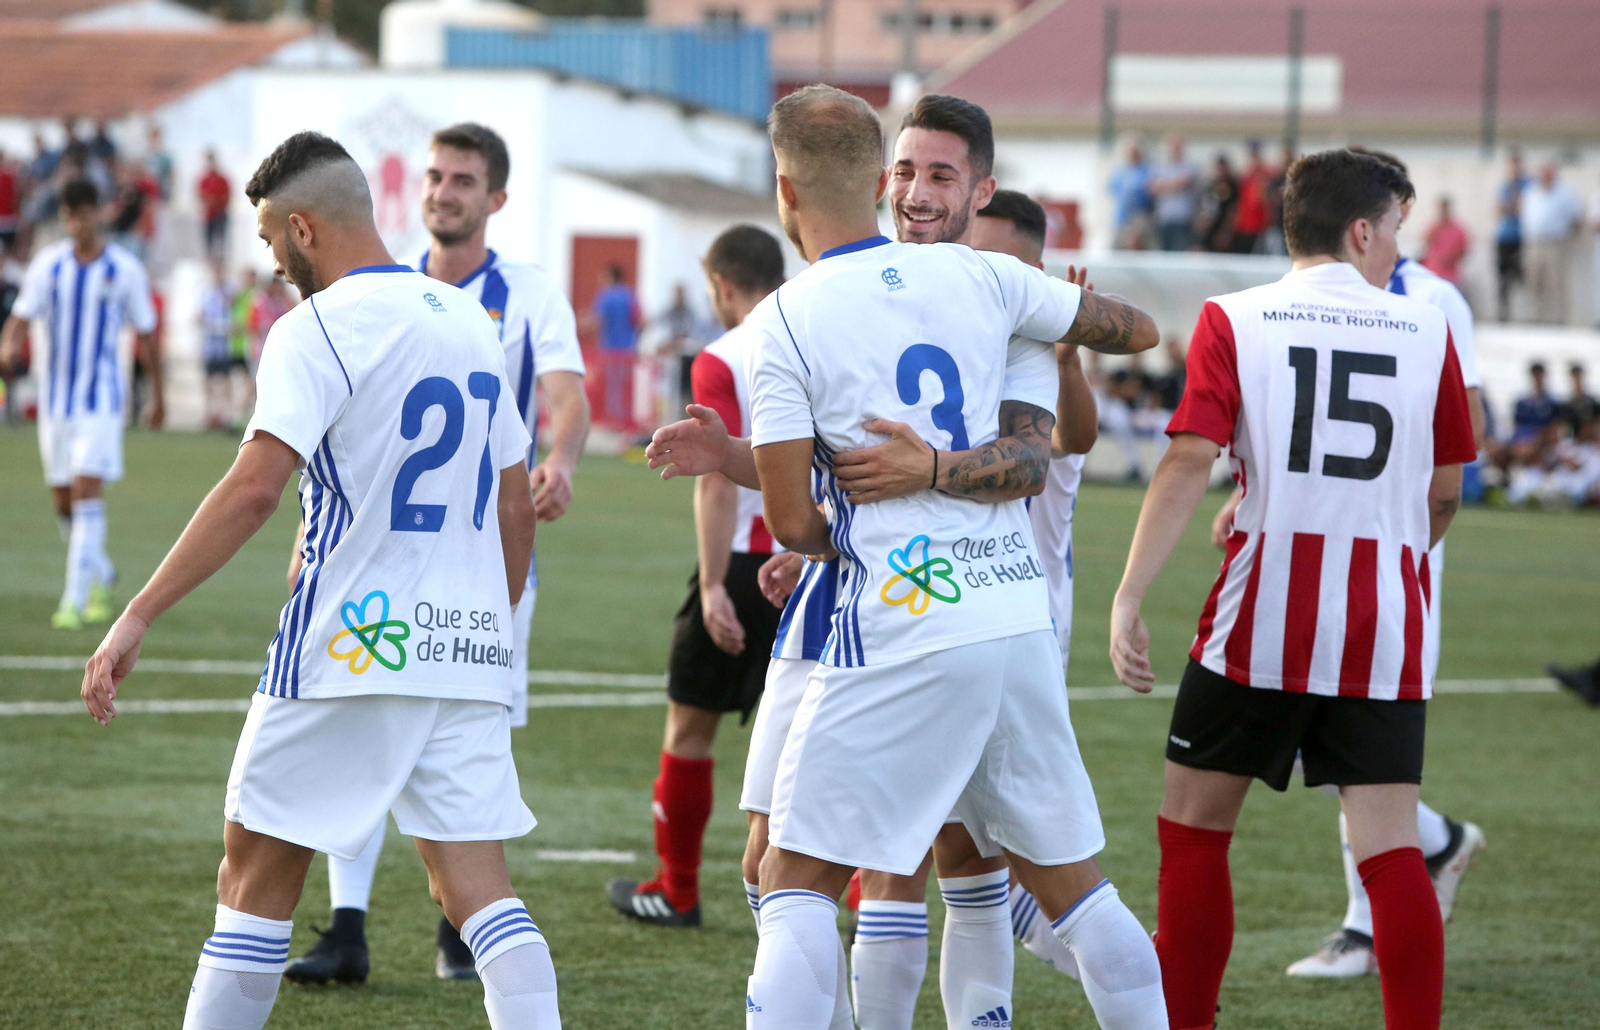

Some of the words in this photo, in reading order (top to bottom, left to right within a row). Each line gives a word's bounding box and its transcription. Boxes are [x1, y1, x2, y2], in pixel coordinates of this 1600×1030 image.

[1290, 302, 1373, 317] AYUNTAMIENTO
[1374, 309, 1389, 318] DE
[1320, 314, 1343, 326] DE
[1287, 346, 1397, 481] 15
[952, 537, 996, 564] Que
[998, 531, 1027, 556] ea
[964, 566, 993, 589] de
[414, 601, 462, 632] Que
[469, 610, 500, 633] sea
[416, 634, 446, 663] de
